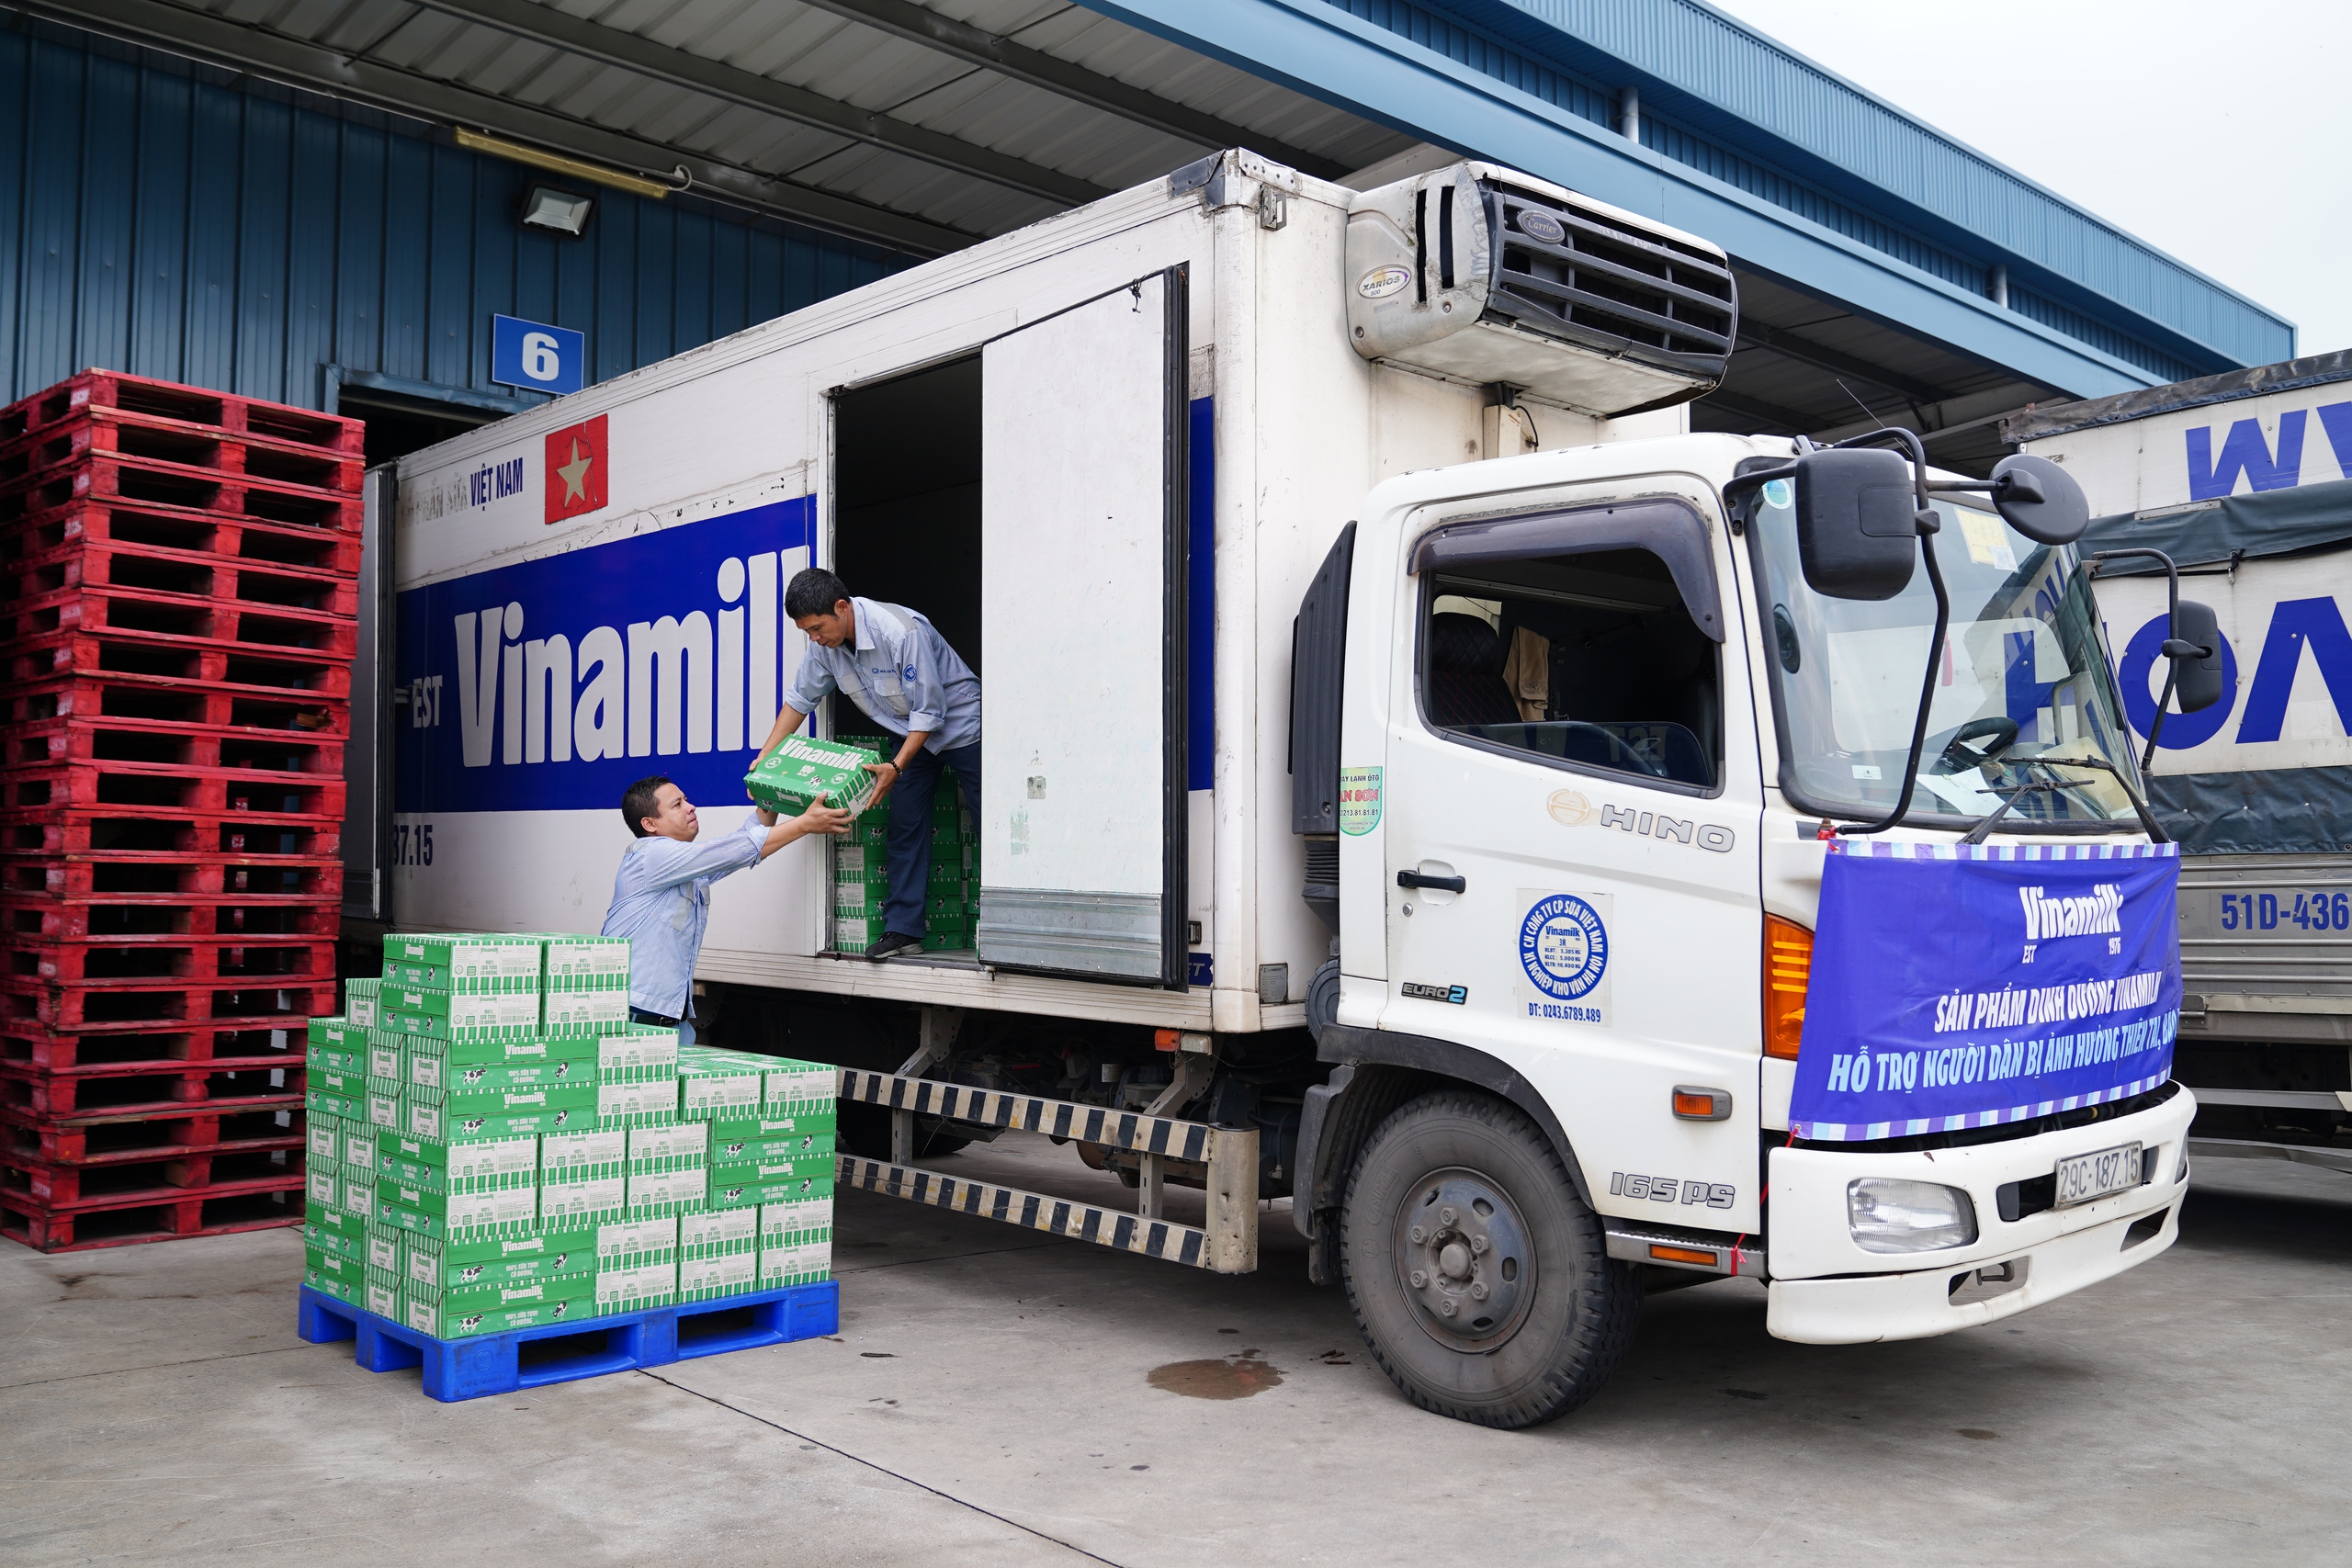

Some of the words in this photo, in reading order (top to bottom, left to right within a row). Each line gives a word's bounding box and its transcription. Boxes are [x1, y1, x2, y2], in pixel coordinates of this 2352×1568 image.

[1527, 218, 1557, 234] Carrier
[1363, 276, 1400, 292] XARIOS
[1370, 288, 1381, 297] 500
[521, 332, 560, 381] 6
[470, 463, 493, 512] VIỆT
[496, 457, 523, 500] NAM
[413, 675, 443, 728] EST
[778, 738, 865, 772] Vinamilk
[1600, 804, 1736, 853] HINO
[1540, 902, 1554, 919] TY
[1553, 899, 1564, 915] CP
[1564, 899, 1582, 919] SỮA
[2018, 883, 2124, 941] Vinamilk
[2222, 892, 2350, 931] 51D-436
[1525, 909, 1544, 935] CÔNG
[1579, 908, 1599, 931] VIỆT
[1523, 934, 1535, 948] CN
[1545, 925, 1580, 937] Vinamilk
[1589, 929, 1604, 953] NAM
[2022, 943, 2038, 964] EST
[2108, 936, 2121, 956] 1976
[1527, 961, 1553, 990] NGHIỆP
[1552, 980, 1569, 997] KHO
[1569, 976, 1587, 996] VẬN
[1588, 954, 1604, 974] NỘI
[1402, 983, 1465, 1004] EURO2
[1528, 1002, 1542, 1018] ĐT:
[1543, 1003, 1601, 1023] 0243.6789.489
[1934, 988, 1973, 1033] SẢN
[1973, 982, 2024, 1030] PHẨM
[2028, 986, 2065, 1025] DINH
[2067, 977, 2115, 1021] DƯỠNG
[504, 1043, 547, 1055] Vinamilk
[1826, 1045, 1871, 1094] HỖ
[1876, 1051, 1921, 1095] TRỢ
[1922, 1041, 1987, 1089] NGƯỜI
[1988, 1038, 2024, 1083] DÂN
[2023, 1037, 2043, 1079] BỊ
[2043, 1032, 2075, 1074] ẢNH
[2074, 1027, 2120, 1068] HƯỞNG
[2120, 1017, 2149, 1058] THIÊN
[503, 1091, 546, 1104] Vinamilk
[760, 1119, 795, 1130] Vinamilk
[758, 1163, 793, 1175] Vinamilk
[2059, 1146, 2139, 1201] 29C-187.15
[1610, 1171, 1679, 1202] 165
[1680, 1180, 1736, 1210] PS
[502, 1237, 544, 1252] Vinamilk
[501, 1285, 543, 1300] Vinamilk
